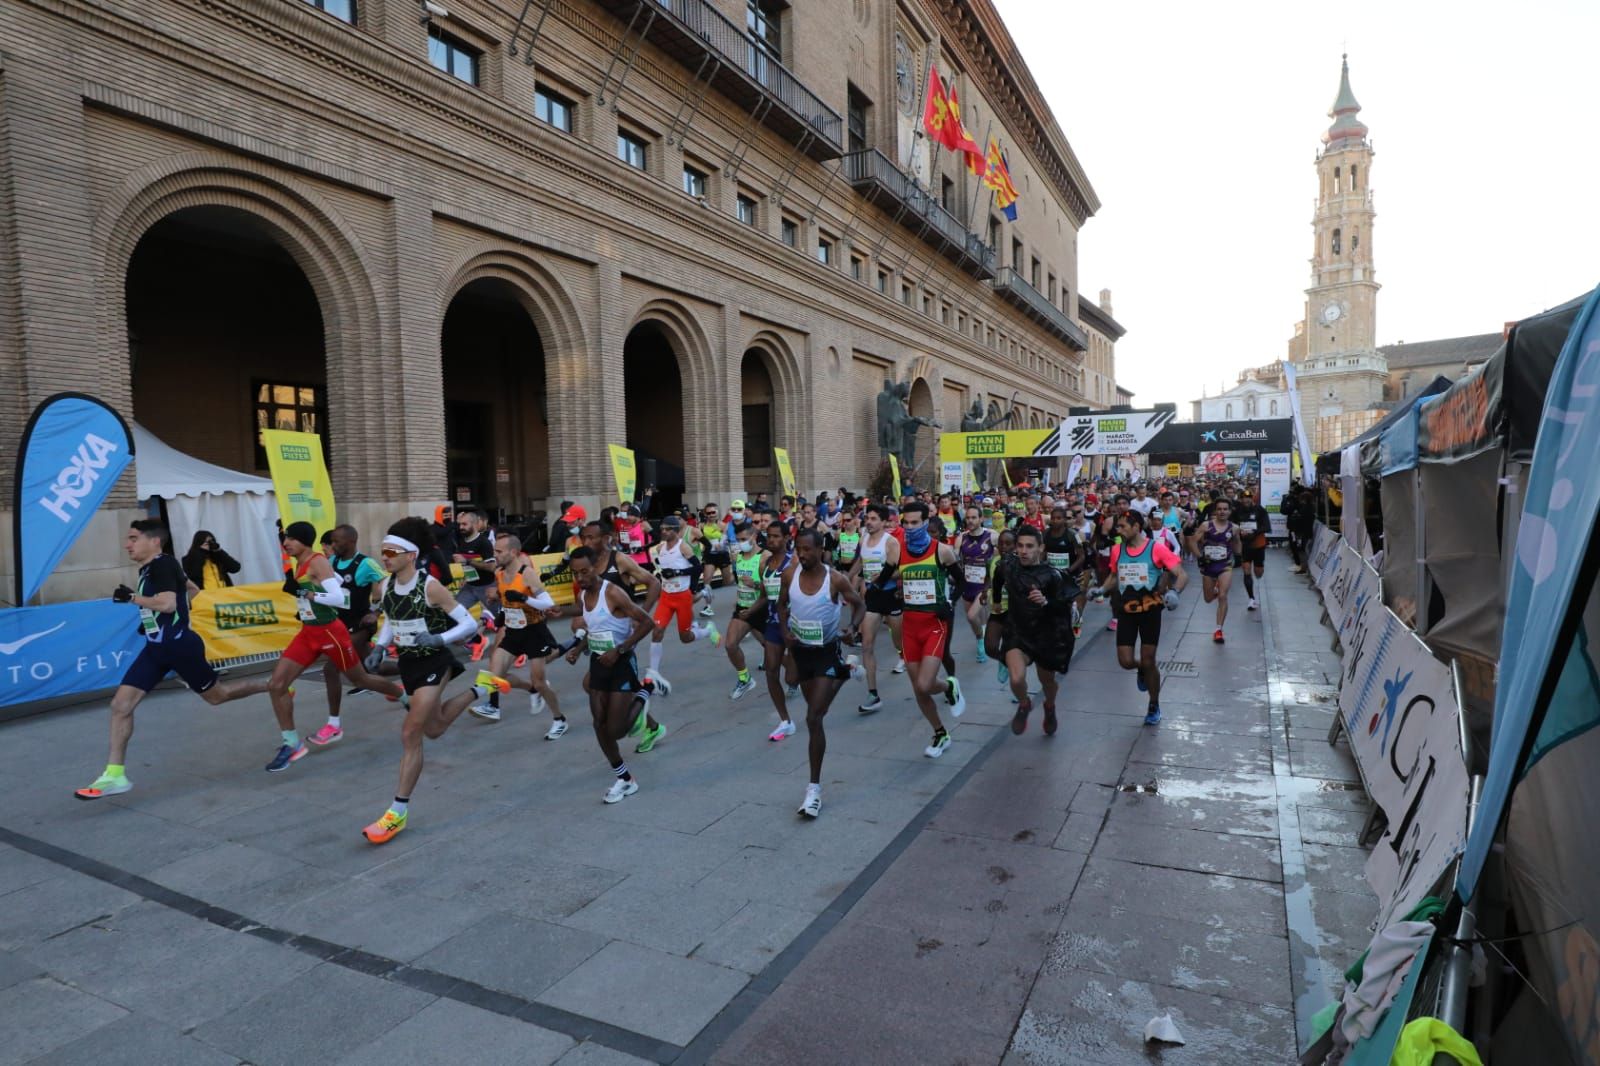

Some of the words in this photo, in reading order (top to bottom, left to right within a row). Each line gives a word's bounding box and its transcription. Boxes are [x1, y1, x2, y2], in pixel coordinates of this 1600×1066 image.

[968, 436, 1003, 445] MANN
[1220, 429, 1268, 440] CaixaBank
[968, 445, 1003, 453] FILTER
[40, 432, 118, 523] HOKA
[218, 602, 272, 618] MANN
[220, 614, 277, 628] FILTER
[7, 662, 53, 684] TO
